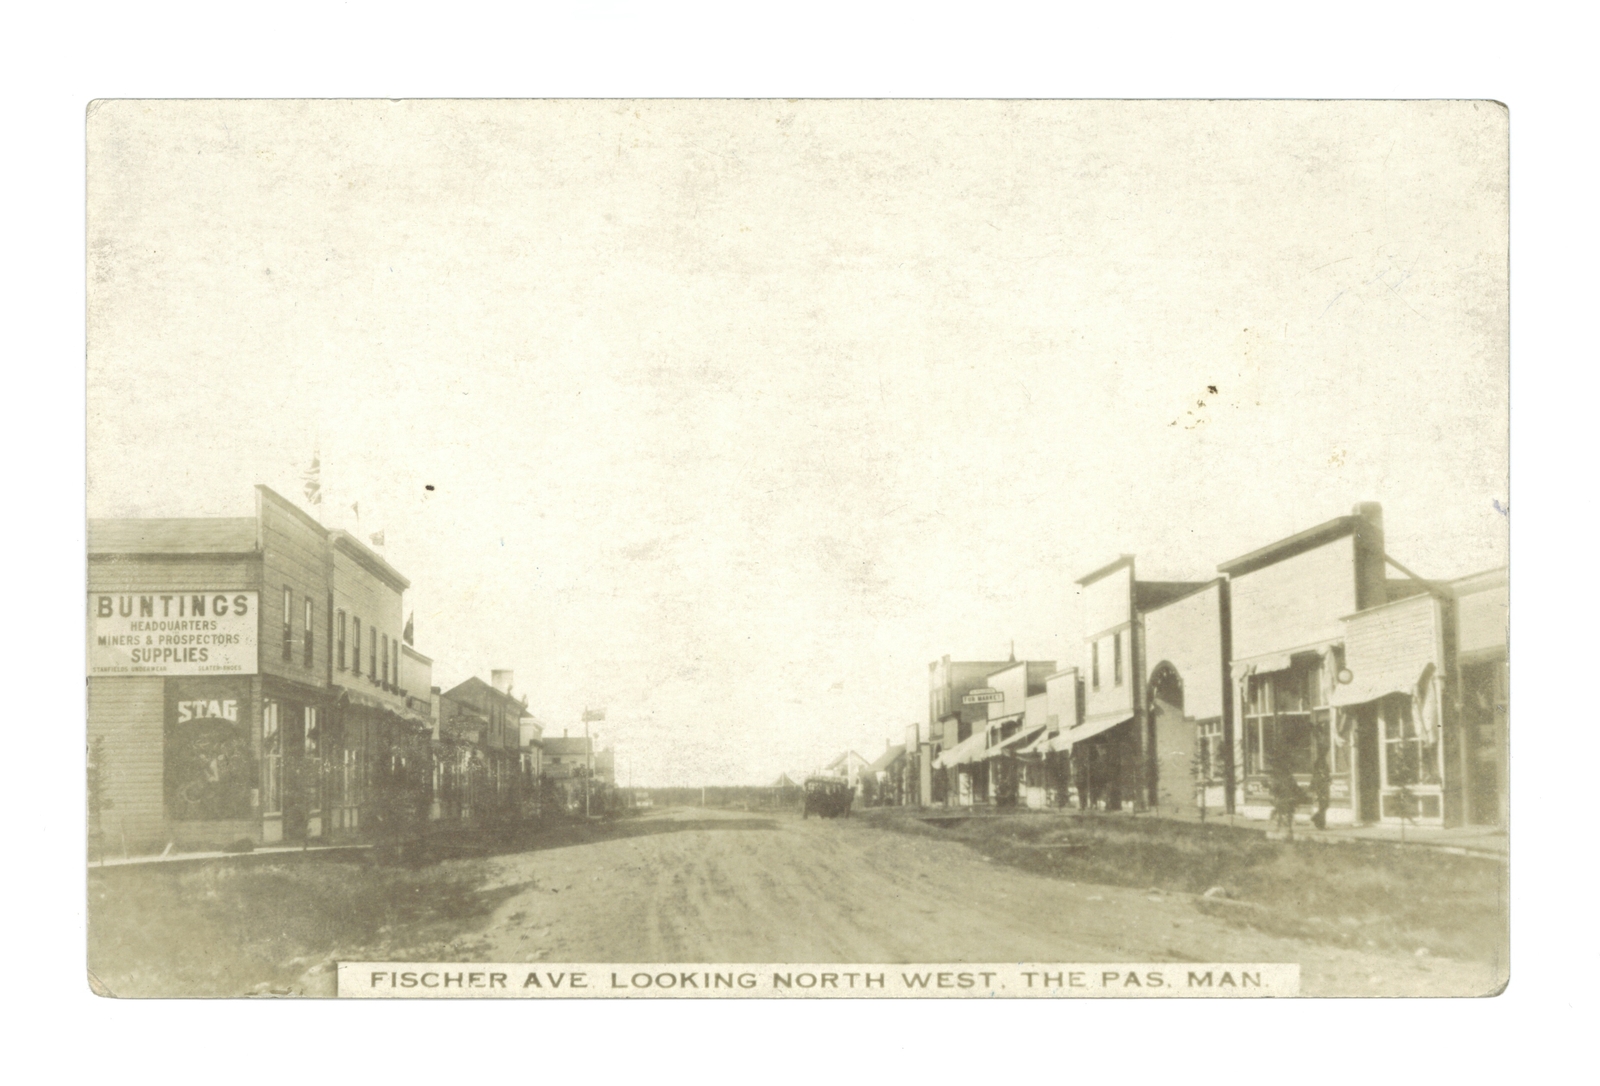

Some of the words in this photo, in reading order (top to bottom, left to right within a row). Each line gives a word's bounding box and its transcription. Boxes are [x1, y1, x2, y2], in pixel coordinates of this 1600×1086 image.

[98, 595, 248, 617] BUNTINGS
[130, 620, 218, 632] HEADQUARTERS
[97, 635, 141, 646] MINERS
[145, 634, 153, 645] &
[158, 634, 240, 645] PROSPECTORS
[131, 648, 209, 663] SUPPLIES
[178, 700, 239, 723] STAG
